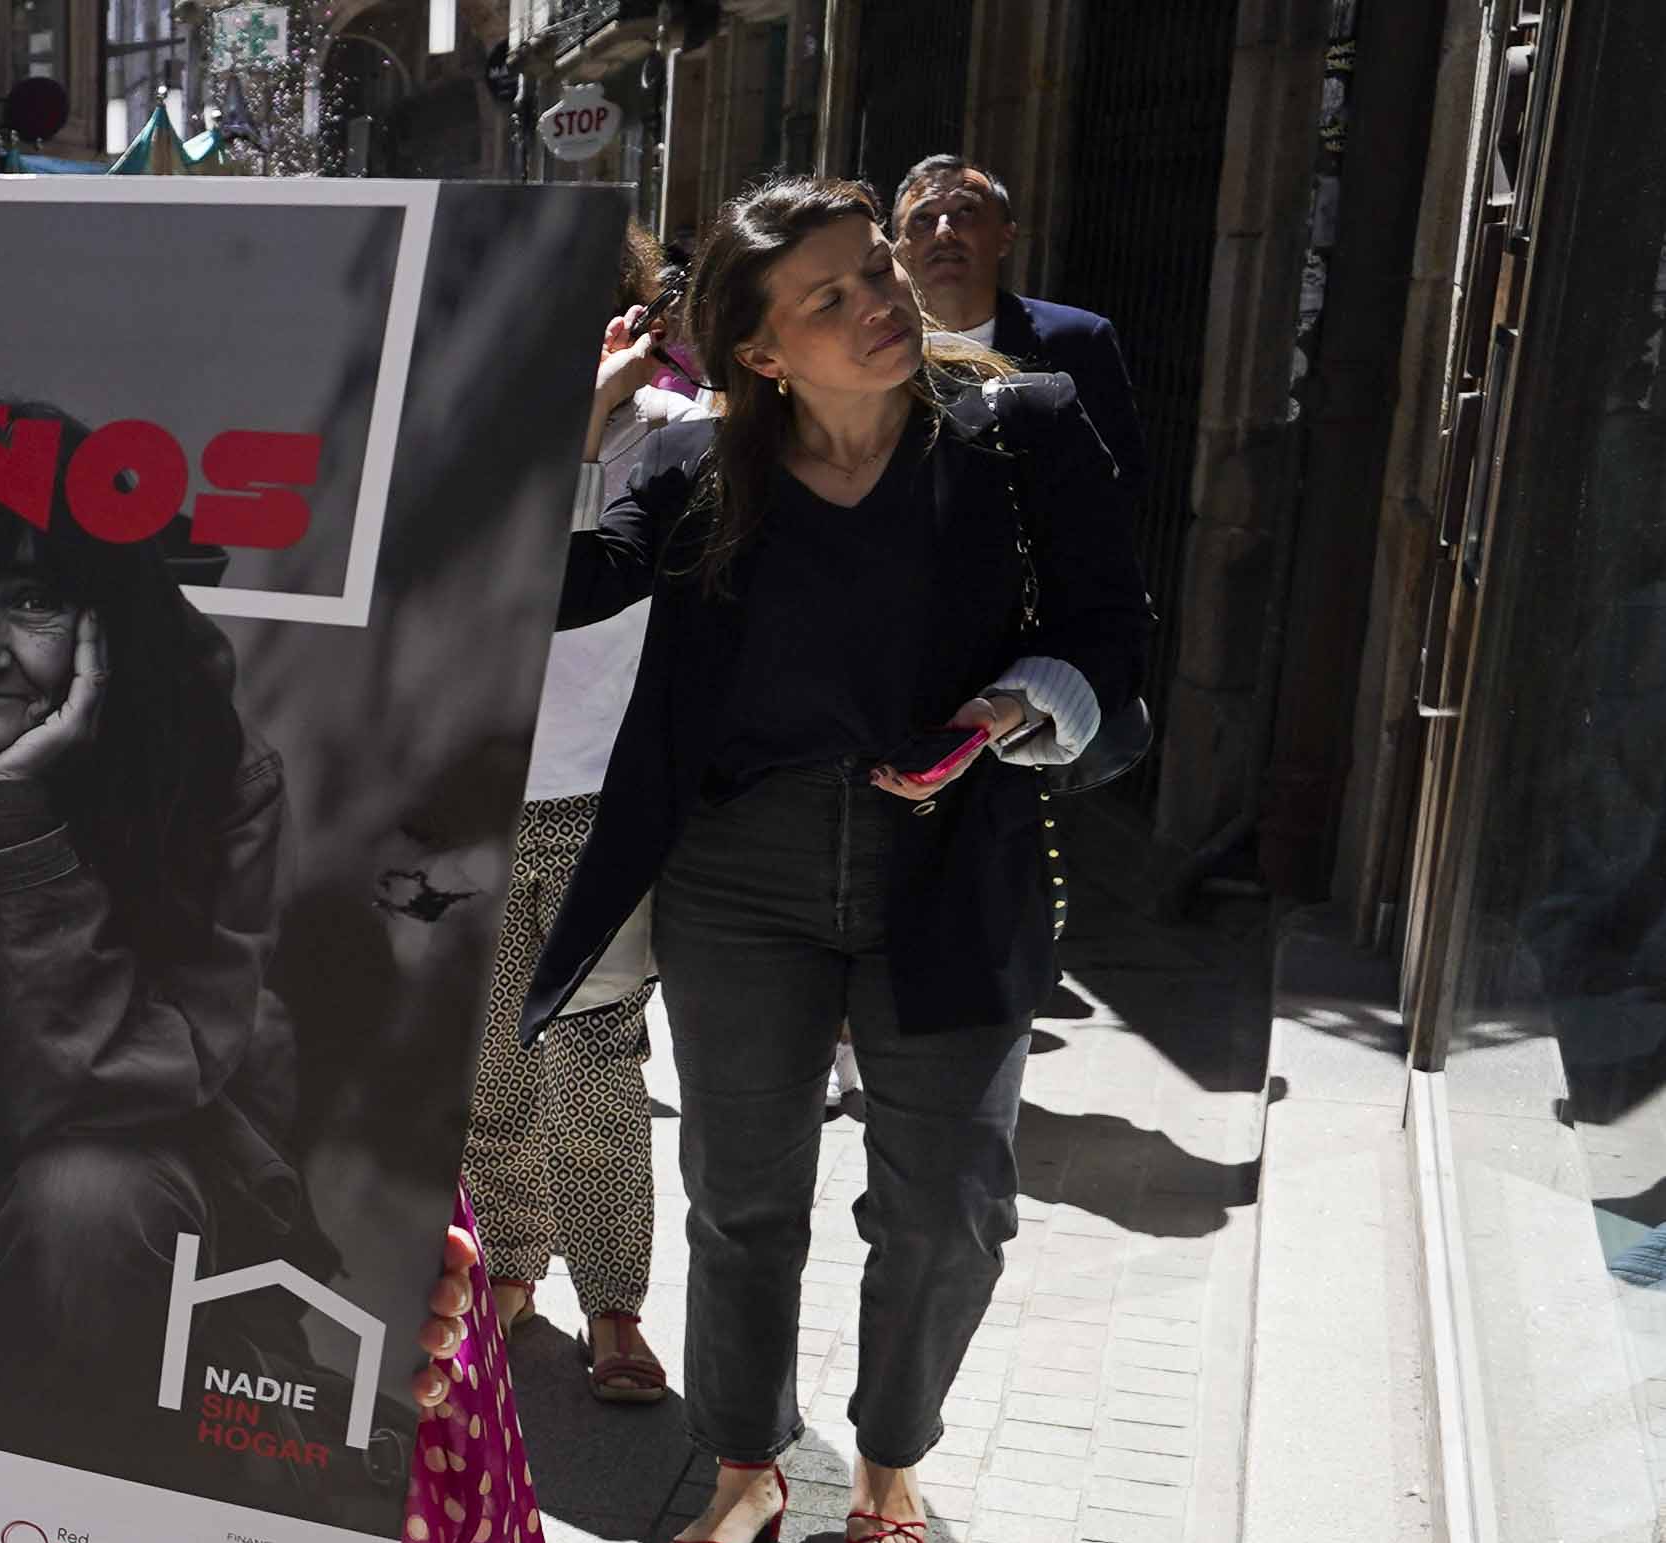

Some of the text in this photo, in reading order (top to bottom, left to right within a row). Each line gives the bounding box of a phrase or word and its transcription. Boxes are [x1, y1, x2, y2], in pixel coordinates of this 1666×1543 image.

[553, 107, 608, 136] STOP
[204, 1366, 316, 1411] NADIE
[201, 1393, 260, 1426] SIN
[199, 1422, 330, 1468] HOGAR
